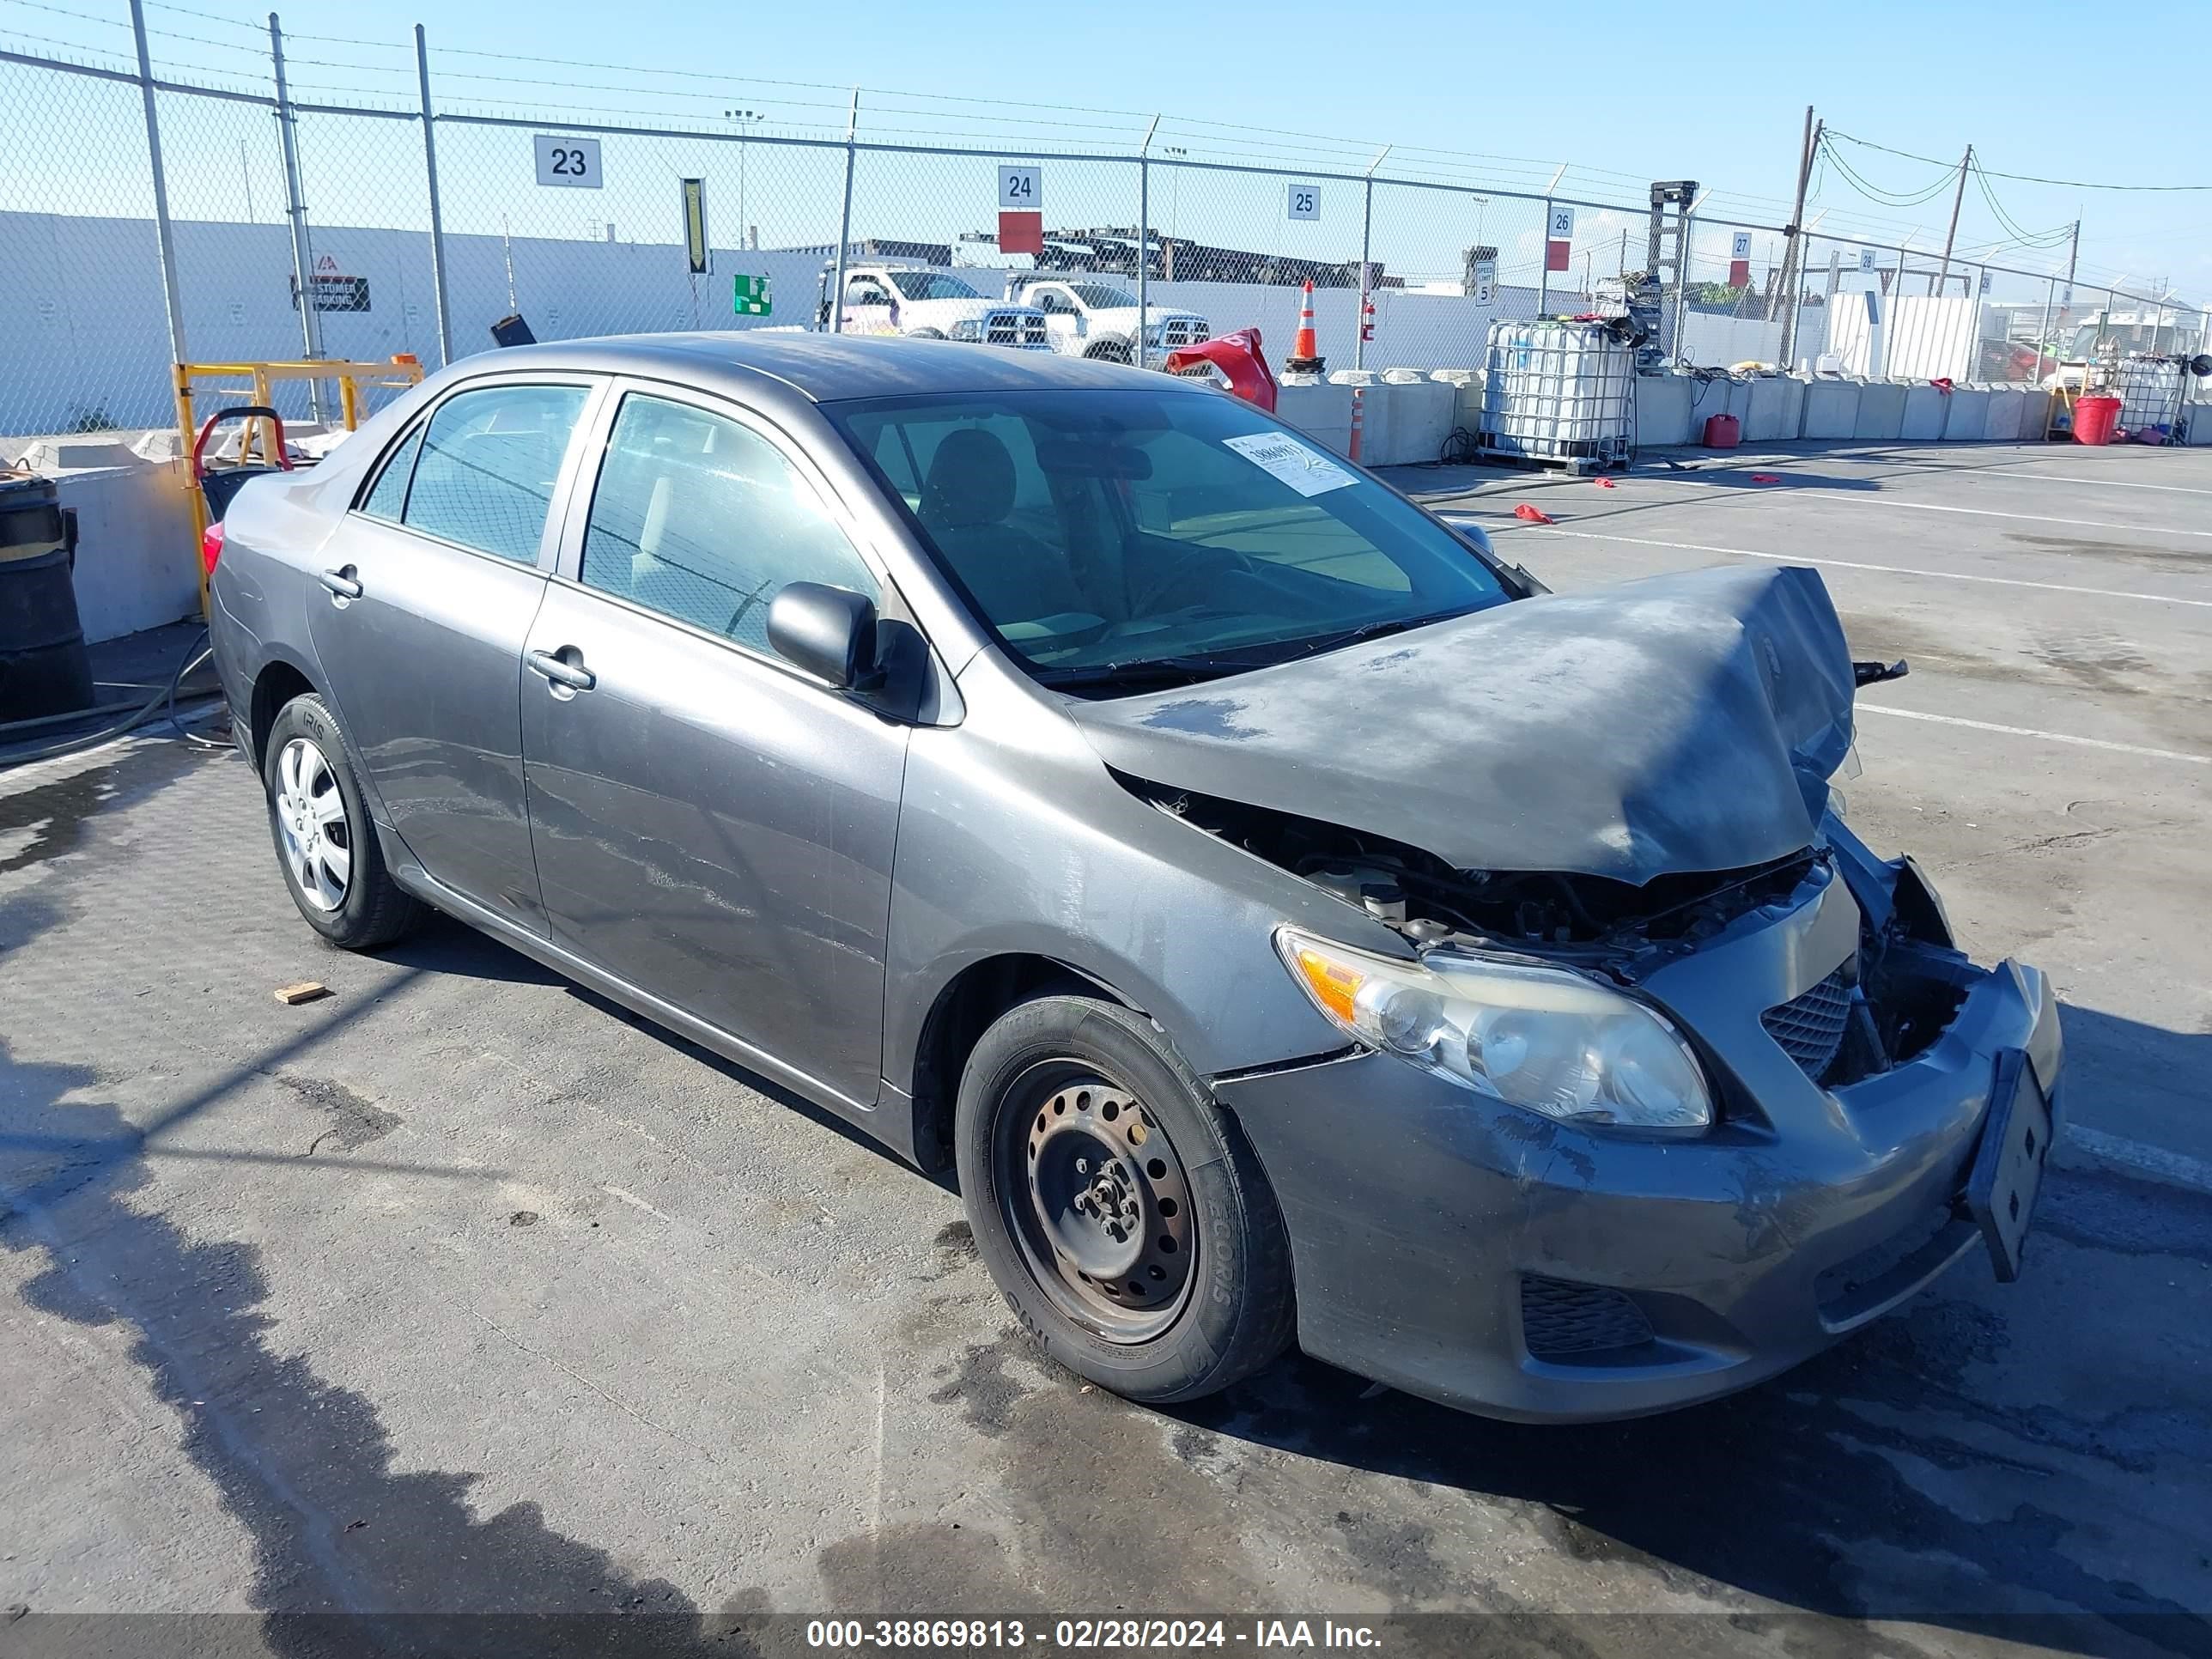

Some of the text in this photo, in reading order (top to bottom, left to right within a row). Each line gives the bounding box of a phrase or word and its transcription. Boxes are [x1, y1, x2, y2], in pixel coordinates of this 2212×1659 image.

[552, 149, 586, 176] 23
[1009, 175, 1031, 198] 24
[1296, 193, 1313, 211] 25
[1556, 215, 1569, 231] 26
[1736, 239, 1747, 252] 27
[1863, 255, 1872, 269] 28
[316, 283, 356, 294] STOMER
[1480, 286, 1489, 301] 5
[303, 712, 325, 740] IRIS
